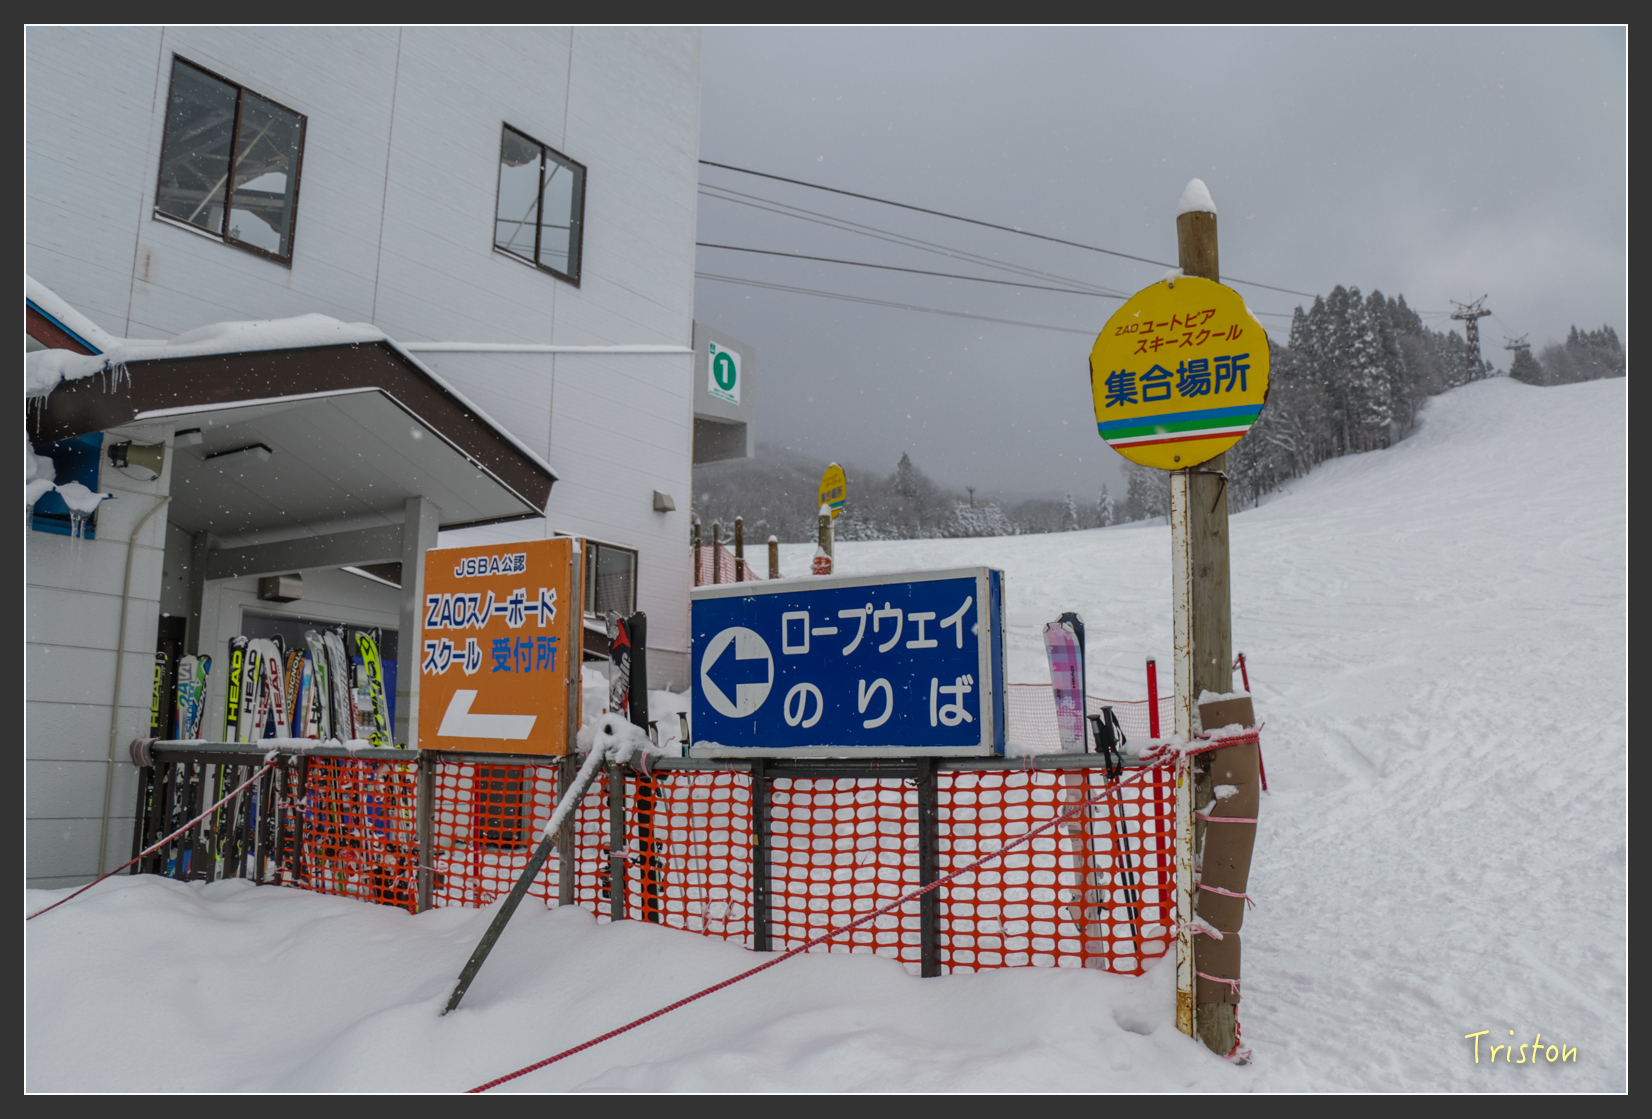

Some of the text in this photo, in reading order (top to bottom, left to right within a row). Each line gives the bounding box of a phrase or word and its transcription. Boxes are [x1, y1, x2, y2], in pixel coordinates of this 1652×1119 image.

[1134, 324, 1243, 355] スキースクール
[719, 359, 729, 384] 1
[1104, 353, 1251, 408] 集合場所
[455, 553, 526, 577] JSBA公認
[426, 588, 557, 628] ZAOスノーボード
[244, 650, 257, 714] HEAD
[423, 636, 557, 675] スクール 受付所
[151, 666, 161, 727] HEAD
[228, 650, 242, 721] HEAD
[269, 658, 284, 725] HEAD
[783, 674, 974, 729] のりば
